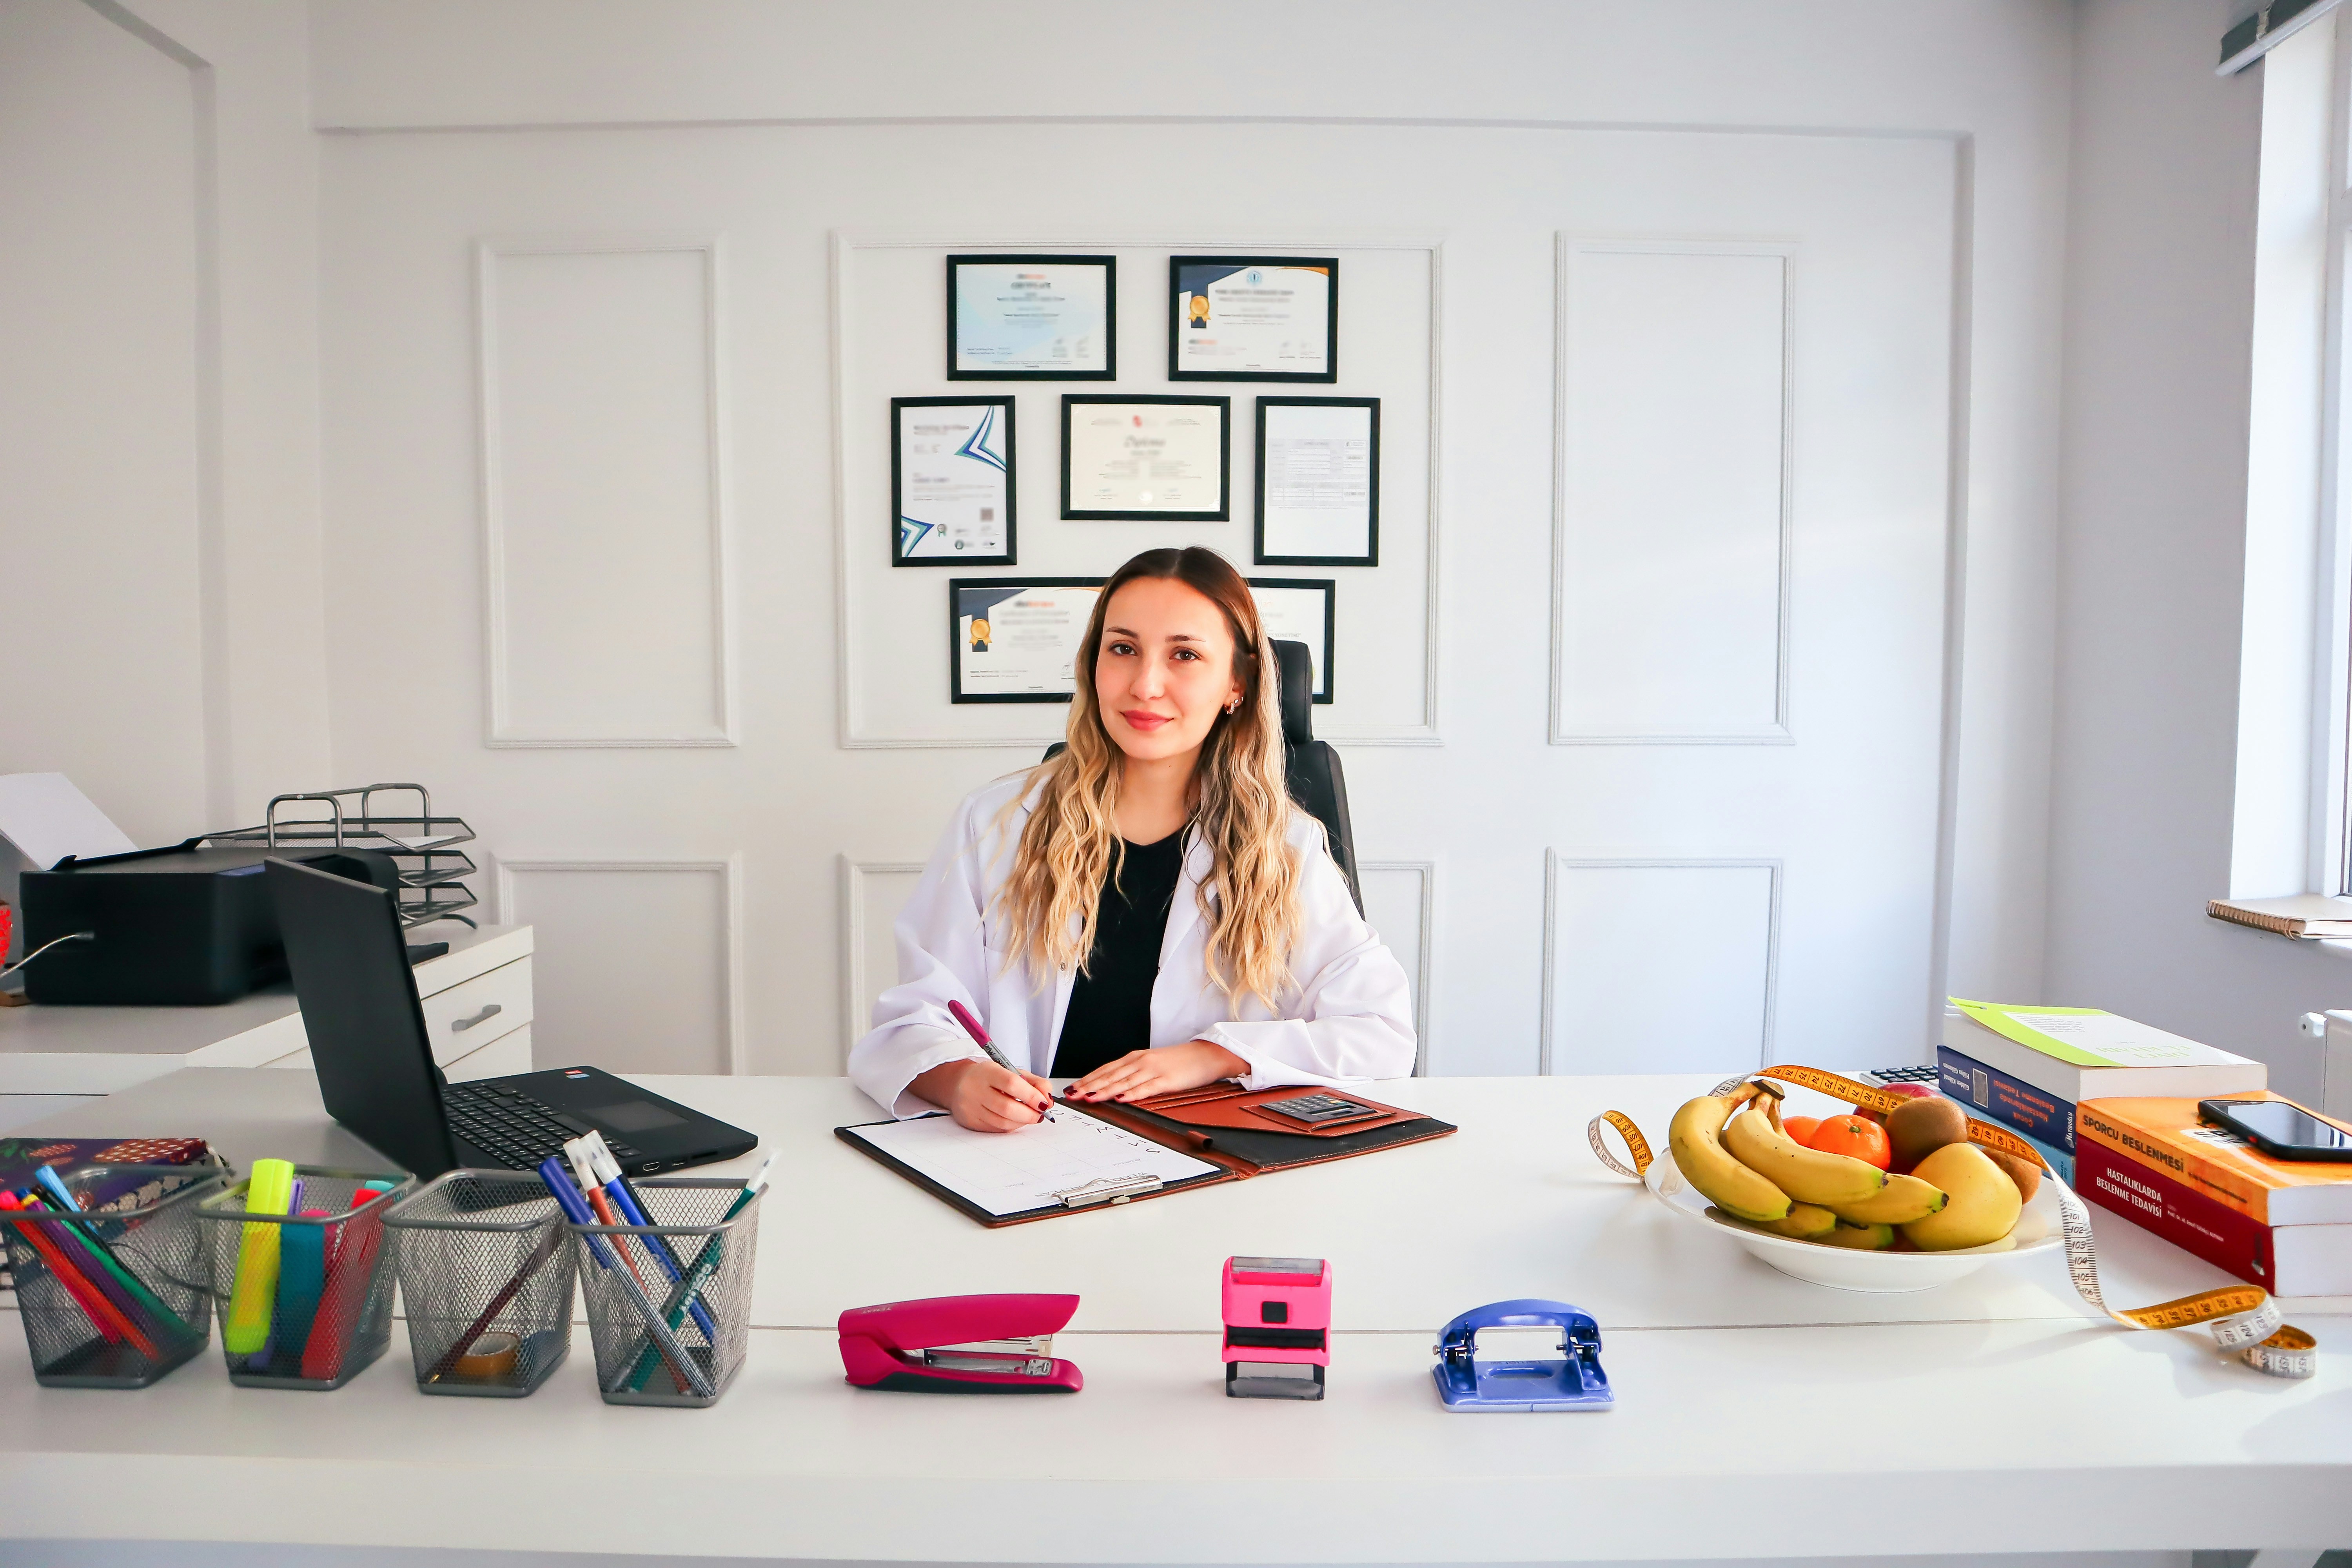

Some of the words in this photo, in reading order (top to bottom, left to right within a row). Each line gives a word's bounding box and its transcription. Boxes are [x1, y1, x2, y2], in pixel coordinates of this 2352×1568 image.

[1799, 1072, 1807, 1081] 75
[1812, 1075, 1819, 1085] 74
[1825, 1079, 1833, 1089] 73
[1838, 1084, 1846, 1094] 72
[1852, 1089, 1859, 1097] 71
[1864, 1092, 1872, 1102] 70
[1878, 1096, 1884, 1106] 69
[1622, 1123, 1631, 1132] 109
[1971, 1126, 1978, 1136] 62
[1985, 1131, 1992, 1139] 61
[1634, 1143, 1643, 1152] 107
[2083, 1114, 2119, 1141] SPORCU
[2122, 1133, 2184, 1173] BESLENMESİ
[2107, 1167, 2162, 1203] HASTALIKLARDA
[2097, 1177, 2129, 1202] BESLENME
[2131, 1192, 2162, 1218] TEDAVİSİ
[2074, 1256, 2088, 1265] 104
[2078, 1273, 2090, 1281] 105
